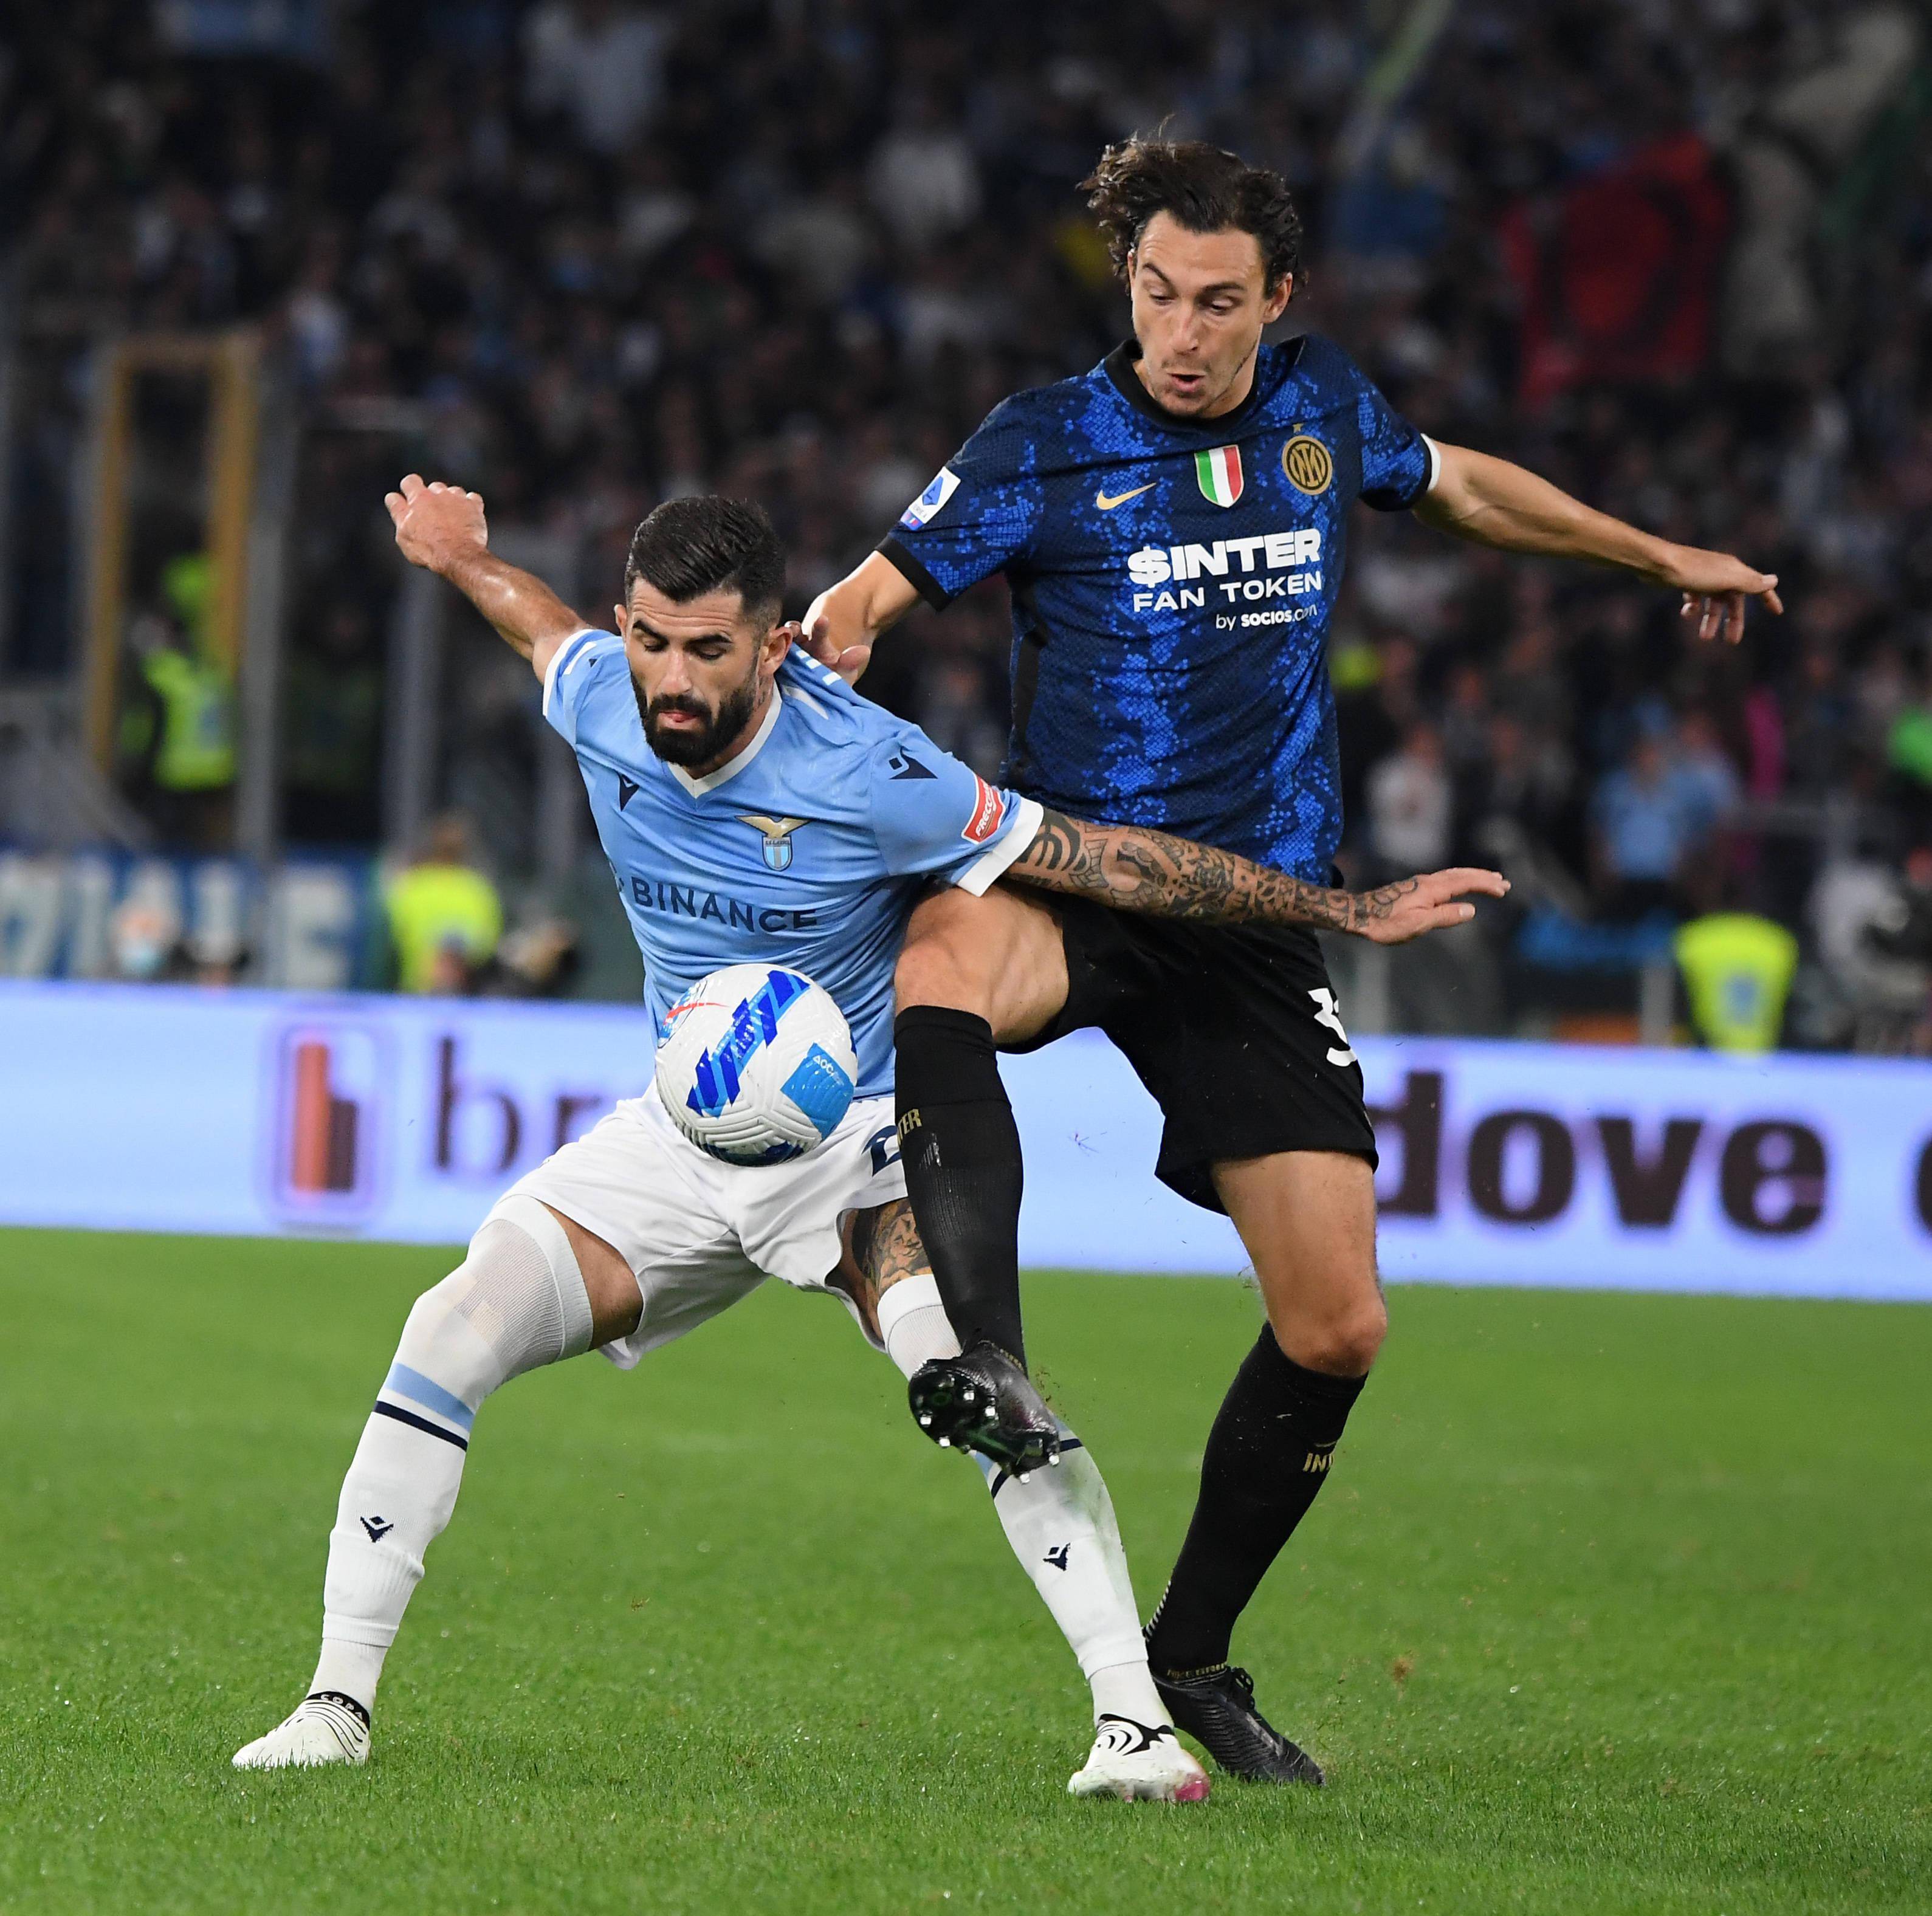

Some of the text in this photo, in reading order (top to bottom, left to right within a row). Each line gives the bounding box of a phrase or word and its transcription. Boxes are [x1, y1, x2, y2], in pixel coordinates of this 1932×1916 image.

[1127, 528, 1321, 588] $INTER
[1133, 571, 1322, 612] FAN TOKEN
[1215, 614, 1237, 631] by
[631, 876, 817, 933] BINANCE
